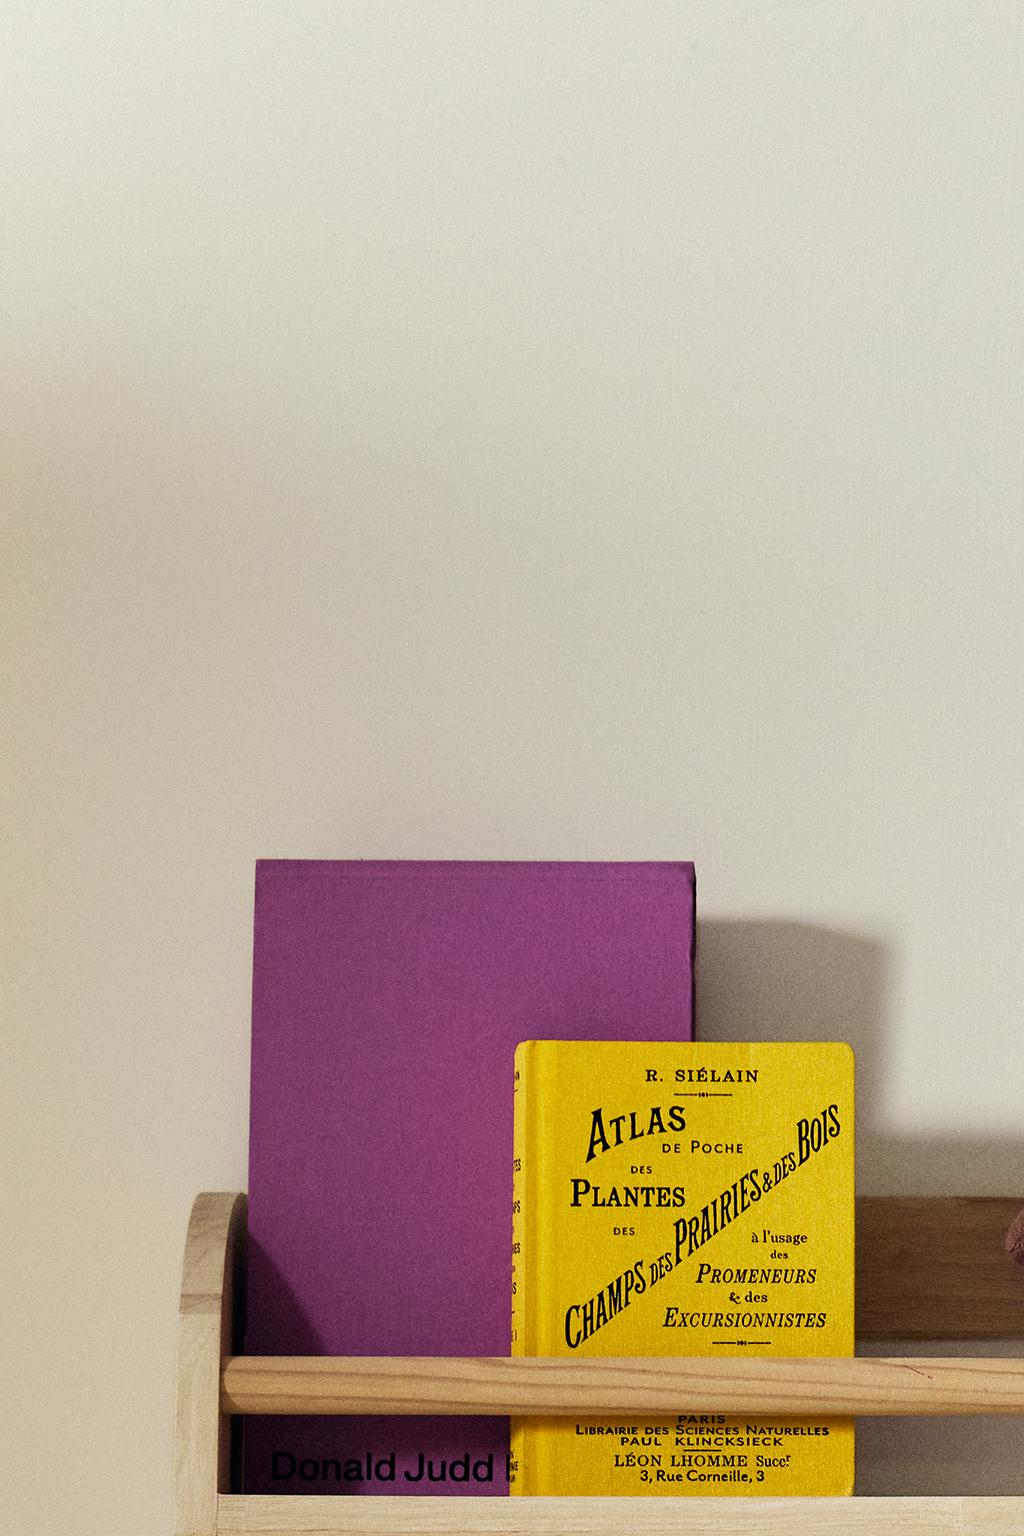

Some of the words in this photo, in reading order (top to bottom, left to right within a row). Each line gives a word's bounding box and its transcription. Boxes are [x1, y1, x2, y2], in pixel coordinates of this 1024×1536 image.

[644, 1069, 664, 1083] R.
[674, 1066, 759, 1083] SIÉLAIN
[585, 1105, 687, 1164] ATLAS
[661, 1142, 681, 1154] DE
[690, 1140, 744, 1154] POCHE
[630, 1165, 653, 1175] DES
[570, 1178, 686, 1208] PLANTES
[564, 1259, 647, 1349] CHAMPS
[648, 1252, 674, 1288] DES
[672, 1168, 763, 1268] PRAIRIES
[762, 1172, 774, 1194] &
[772, 1151, 798, 1187] DES
[796, 1103, 842, 1167] BOIS
[613, 1226, 636, 1236] DES
[750, 1232, 760, 1244] à
[762, 1229, 809, 1246] l'usage
[769, 1249, 790, 1260] des
[695, 1263, 818, 1285] PROMENEURS
[728, 1291, 742, 1305] &
[744, 1291, 769, 1304] des
[662, 1306, 828, 1329] EXCURSIONNISTES
[677, 1415, 727, 1425] PARIS
[575, 1424, 639, 1436] LIBRAIRIE
[644, 1426, 670, 1436] DES
[675, 1425, 740, 1436] SCIENCES
[745, 1425, 831, 1437] NATURELLES
[620, 1437, 663, 1447] PAUL
[675, 1437, 784, 1447] KLINCKSIECK
[271, 1452, 397, 1481] Donald
[404, 1453, 494, 1482] Judd
[614, 1451, 662, 1468] LÉON
[670, 1454, 748, 1468] LHOMME
[640, 1469, 653, 1483] 3,
[656, 1470, 684, 1483] Rue
[686, 1469, 753, 1484] Corneille,
[756, 1470, 765, 1482] 3
